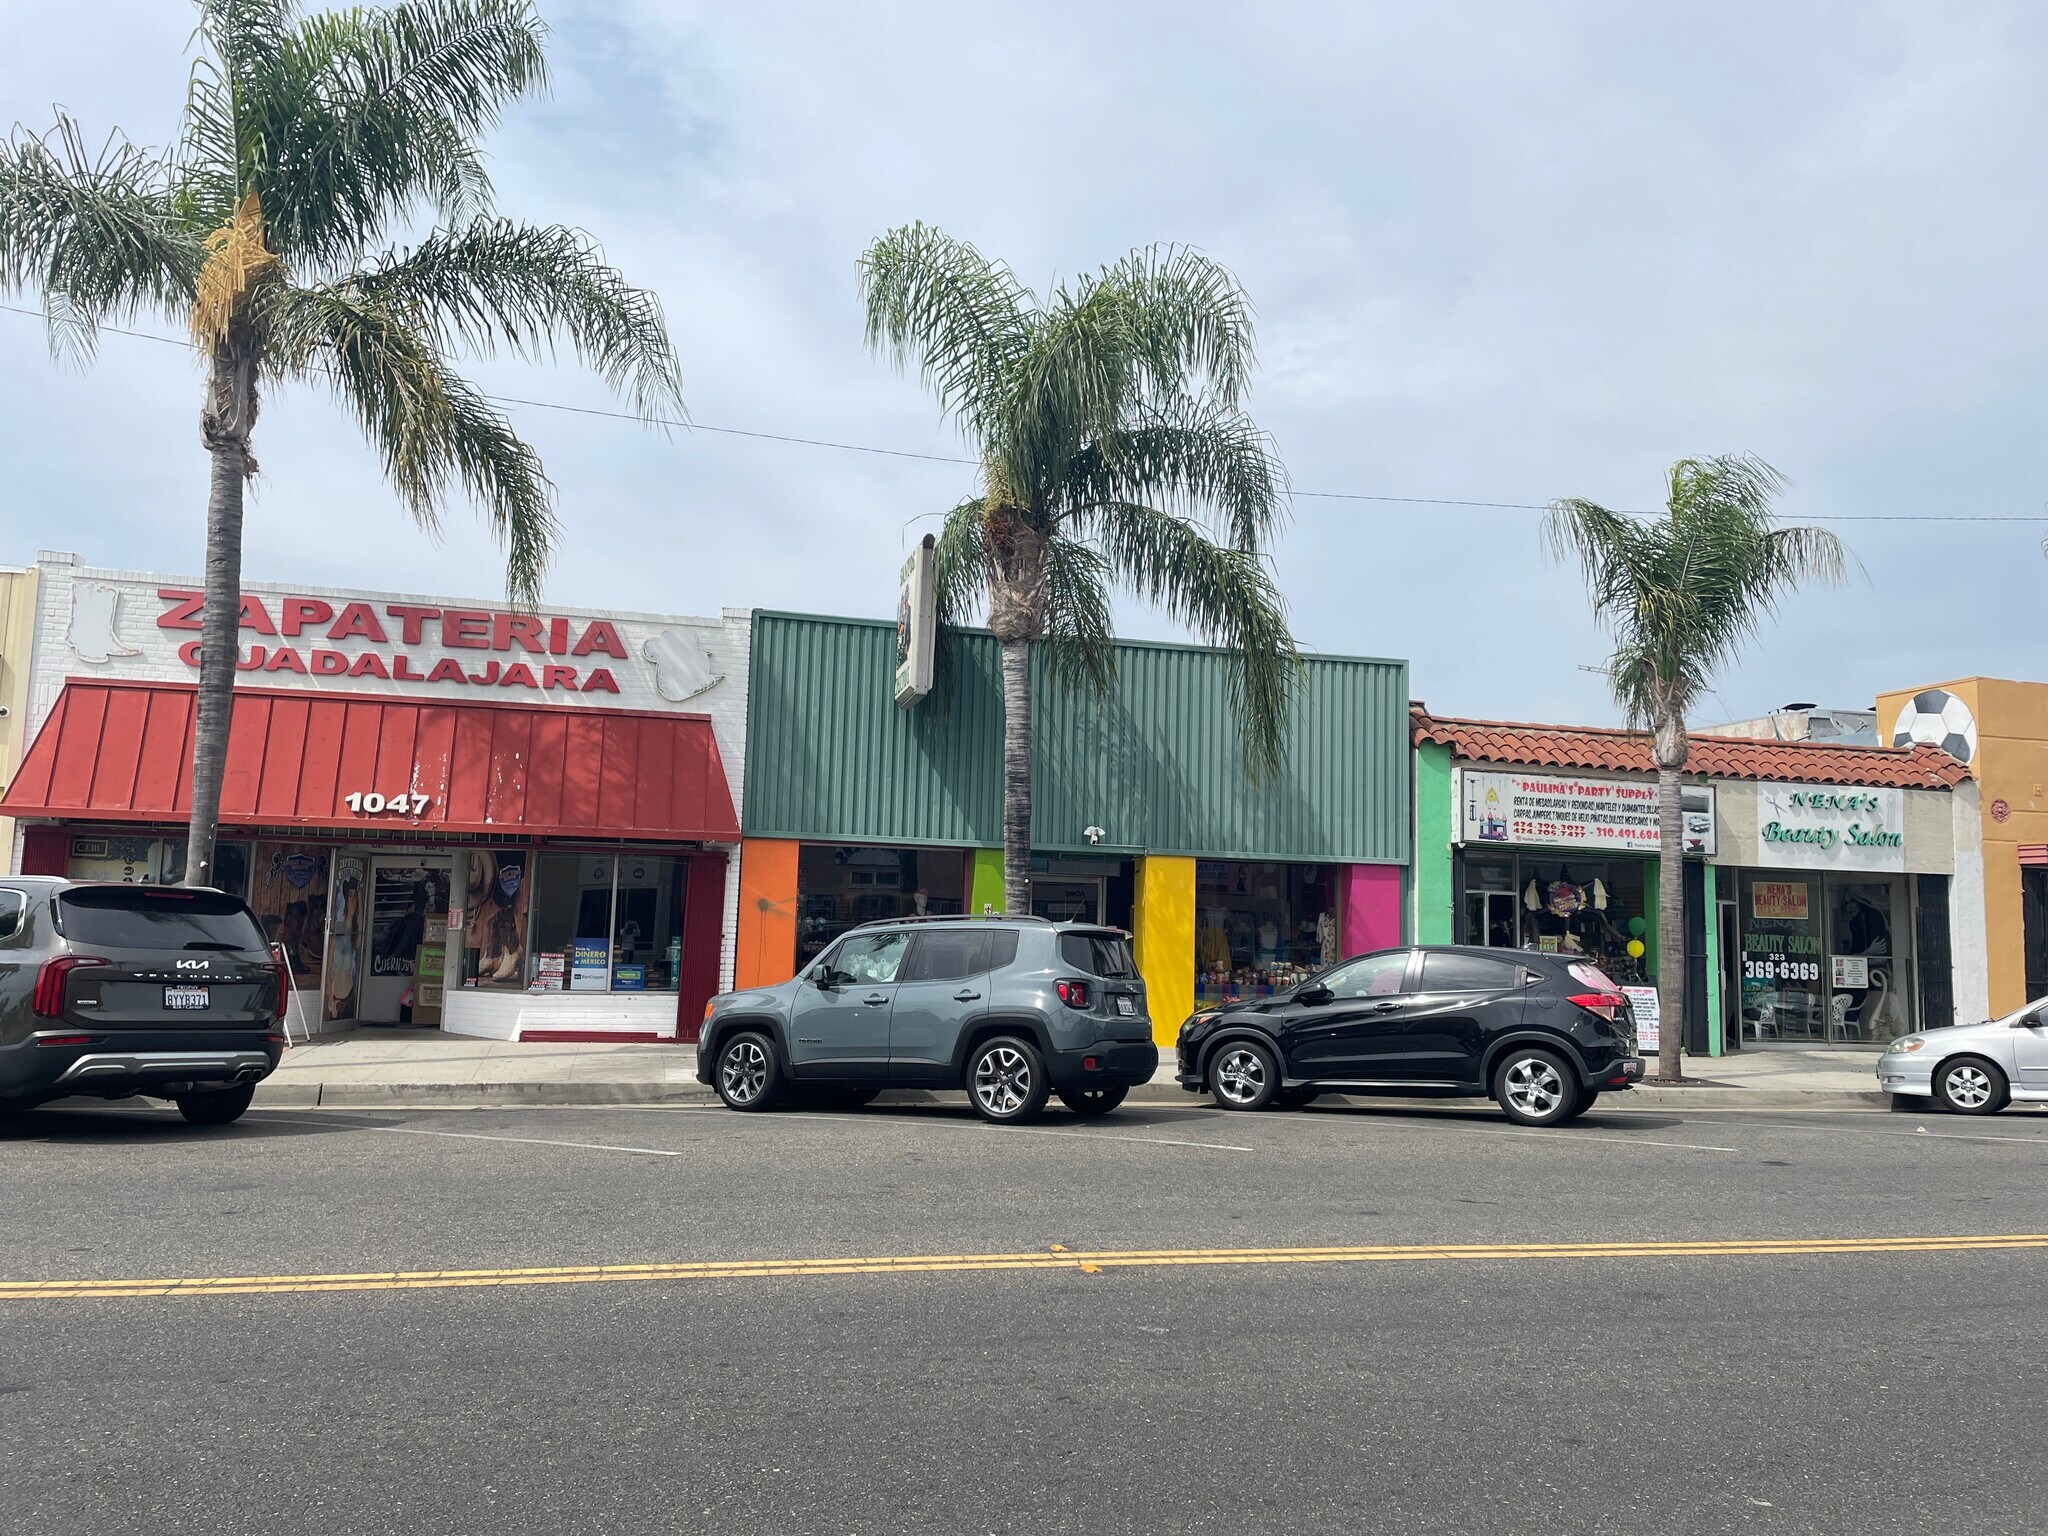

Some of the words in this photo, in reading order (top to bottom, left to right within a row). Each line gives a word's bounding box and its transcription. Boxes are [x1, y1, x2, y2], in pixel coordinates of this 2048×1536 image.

[156, 588, 629, 659] ZAPATERIA
[1522, 781, 1574, 796] PAULINA'S
[1577, 784, 1611, 798] PARTY
[1615, 786, 1655, 801] SUPPLY
[344, 791, 430, 815] 1047
[1513, 796, 1528, 807] RENTA
[1529, 797, 1535, 807] DE
[1789, 791, 1879, 813] NENA'S
[1572, 812, 1578, 822] DE
[1625, 815, 1649, 827] MEXICANOS
[1596, 826, 1661, 840] 310.491.684
[1761, 821, 1840, 850] Beauty
[1843, 823, 1903, 848] Salon
[1766, 884, 1792, 895] NENA'S
[1755, 894, 1780, 906] BEAUTY
[1783, 895, 1806, 907] SALON
[1749, 919, 1809, 934] NENA'S
[1744, 933, 1785, 953] BEAUTY
[1787, 935, 1821, 955] SALON
[575, 950, 606, 958] DINERO
[1769, 953, 1785, 961] 323
[167, 994, 206, 1006] 8YYB371
